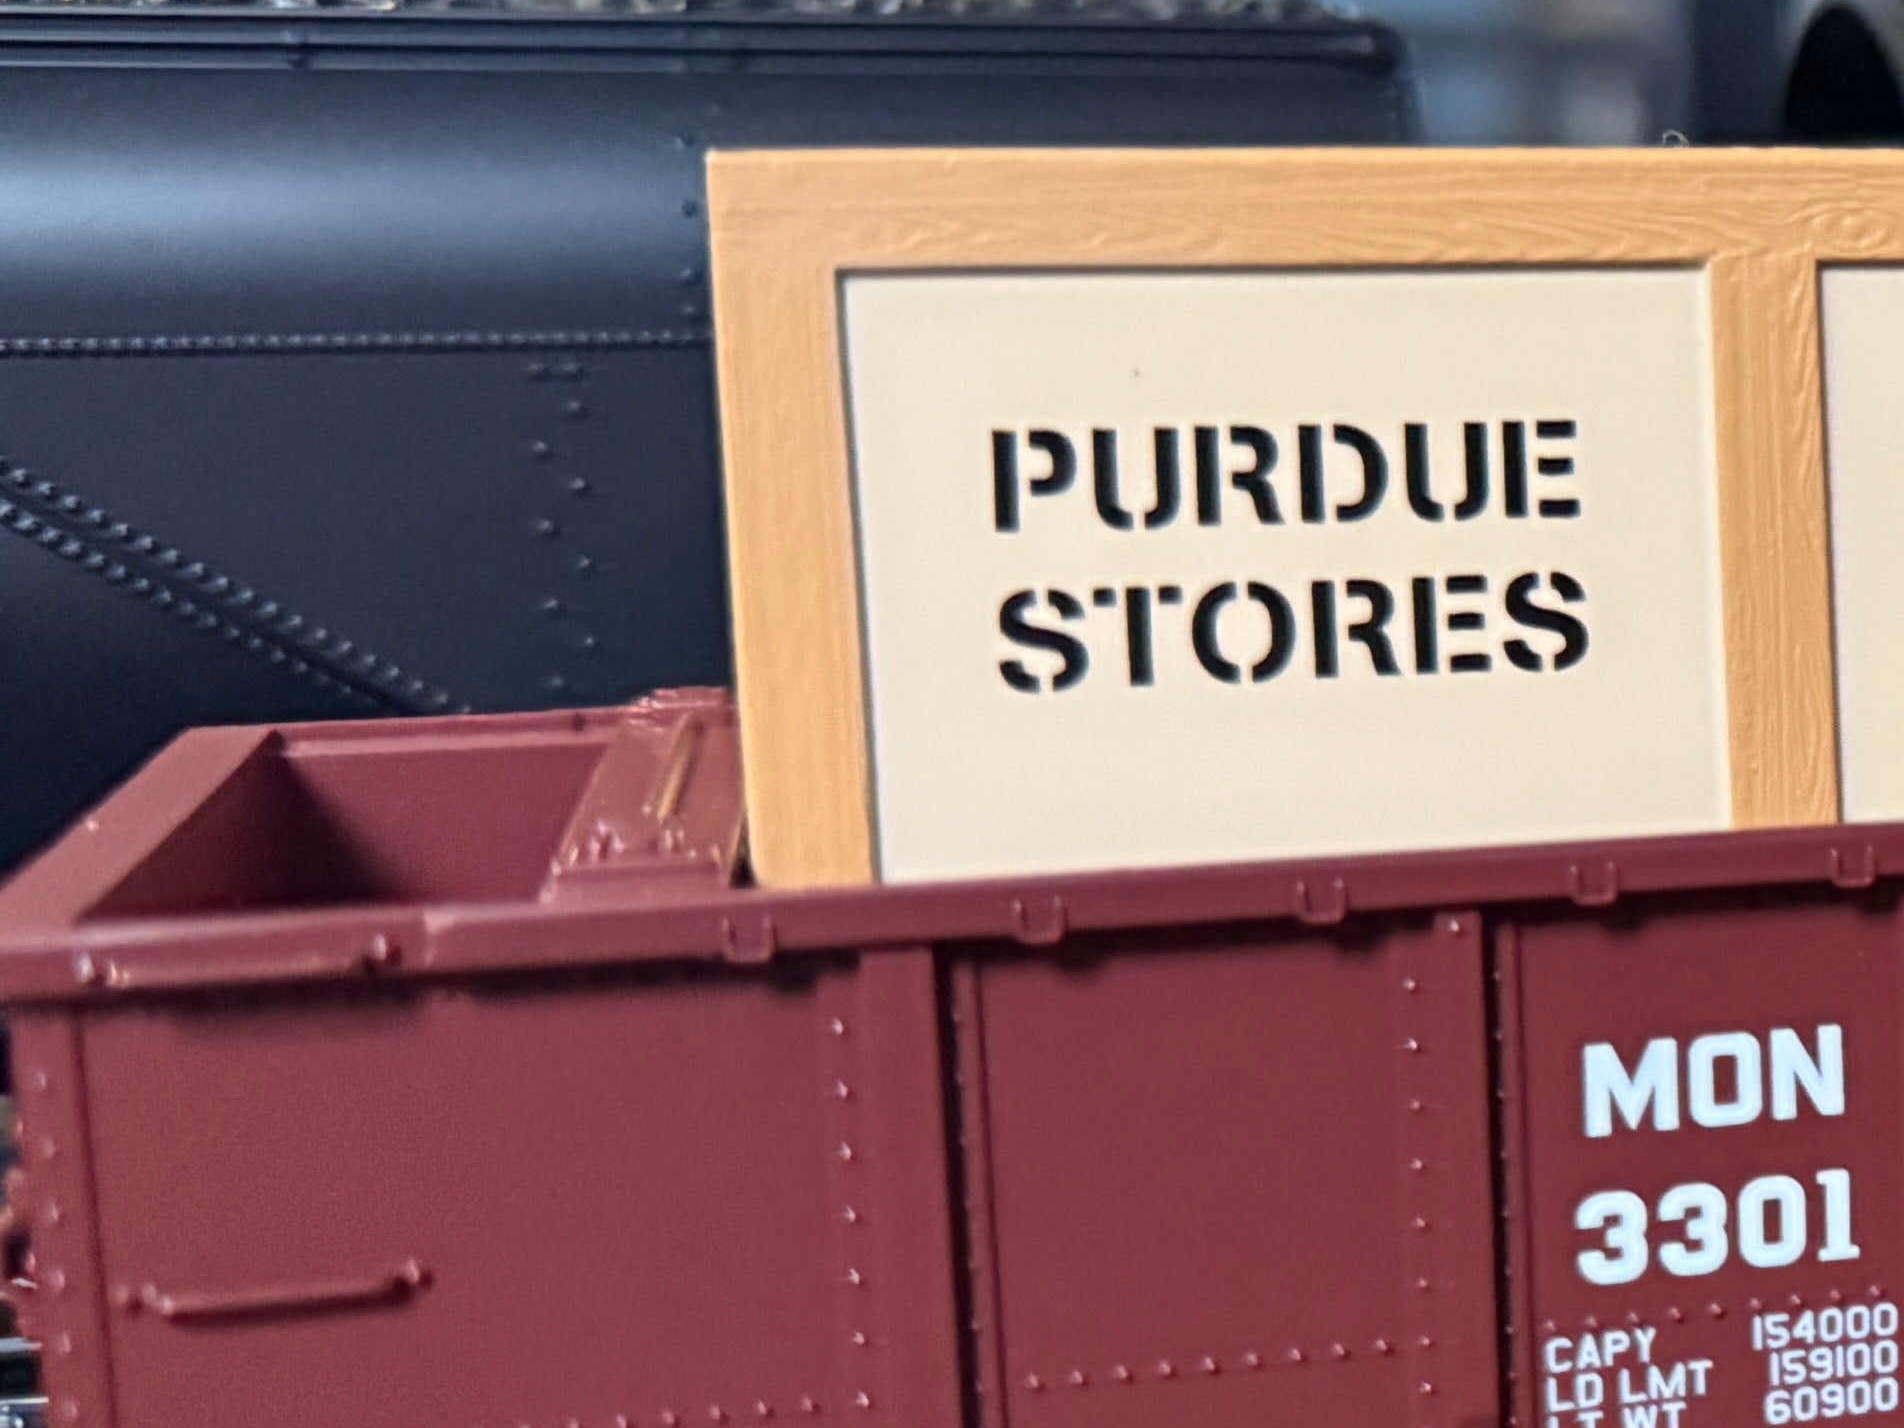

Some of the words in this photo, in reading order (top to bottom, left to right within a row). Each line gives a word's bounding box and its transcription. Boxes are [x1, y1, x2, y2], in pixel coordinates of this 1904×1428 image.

[992, 419, 1581, 533] PURDUE
[997, 571, 1589, 694] STORES
[1582, 1023, 1845, 1138] MON
[1574, 1168, 1861, 1286] 3301
[1544, 1326, 1657, 1374] CAPY
[1751, 1302, 1899, 1351] 154000
[1545, 1372, 1604, 1414] LD
[1618, 1359, 1714, 1405] LMT
[1768, 1339, 1899, 1387] 159100
[1763, 1377, 1899, 1426] 60900
